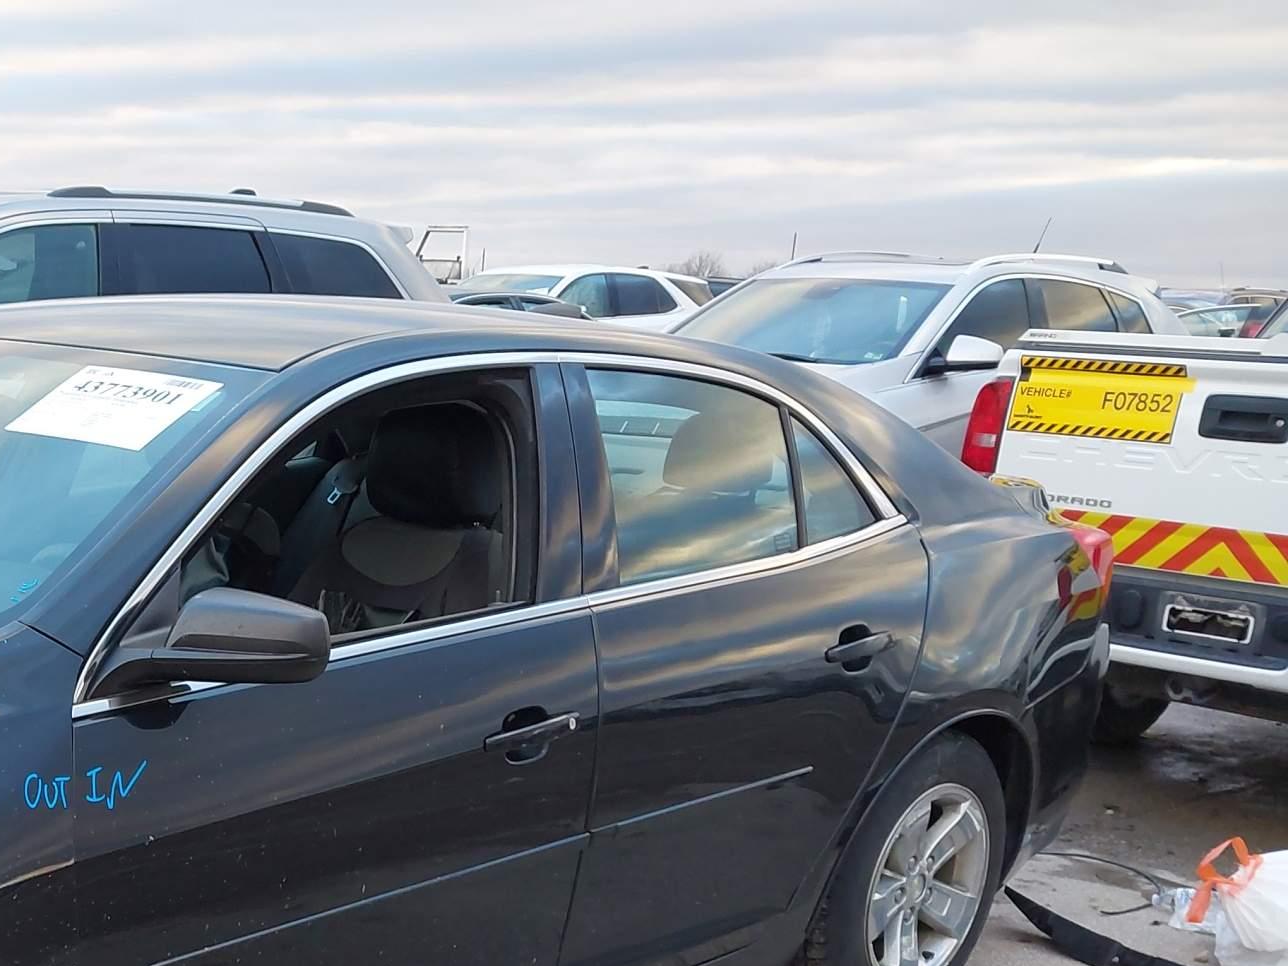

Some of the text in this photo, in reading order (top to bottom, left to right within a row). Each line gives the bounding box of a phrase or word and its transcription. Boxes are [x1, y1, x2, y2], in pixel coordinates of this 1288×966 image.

[73, 380, 184, 405] 43773901
[1020, 386, 1174, 413] VEHICLE# F07852
[1047, 494, 1112, 508] ORADO
[24, 759, 148, 809] OUT IN
